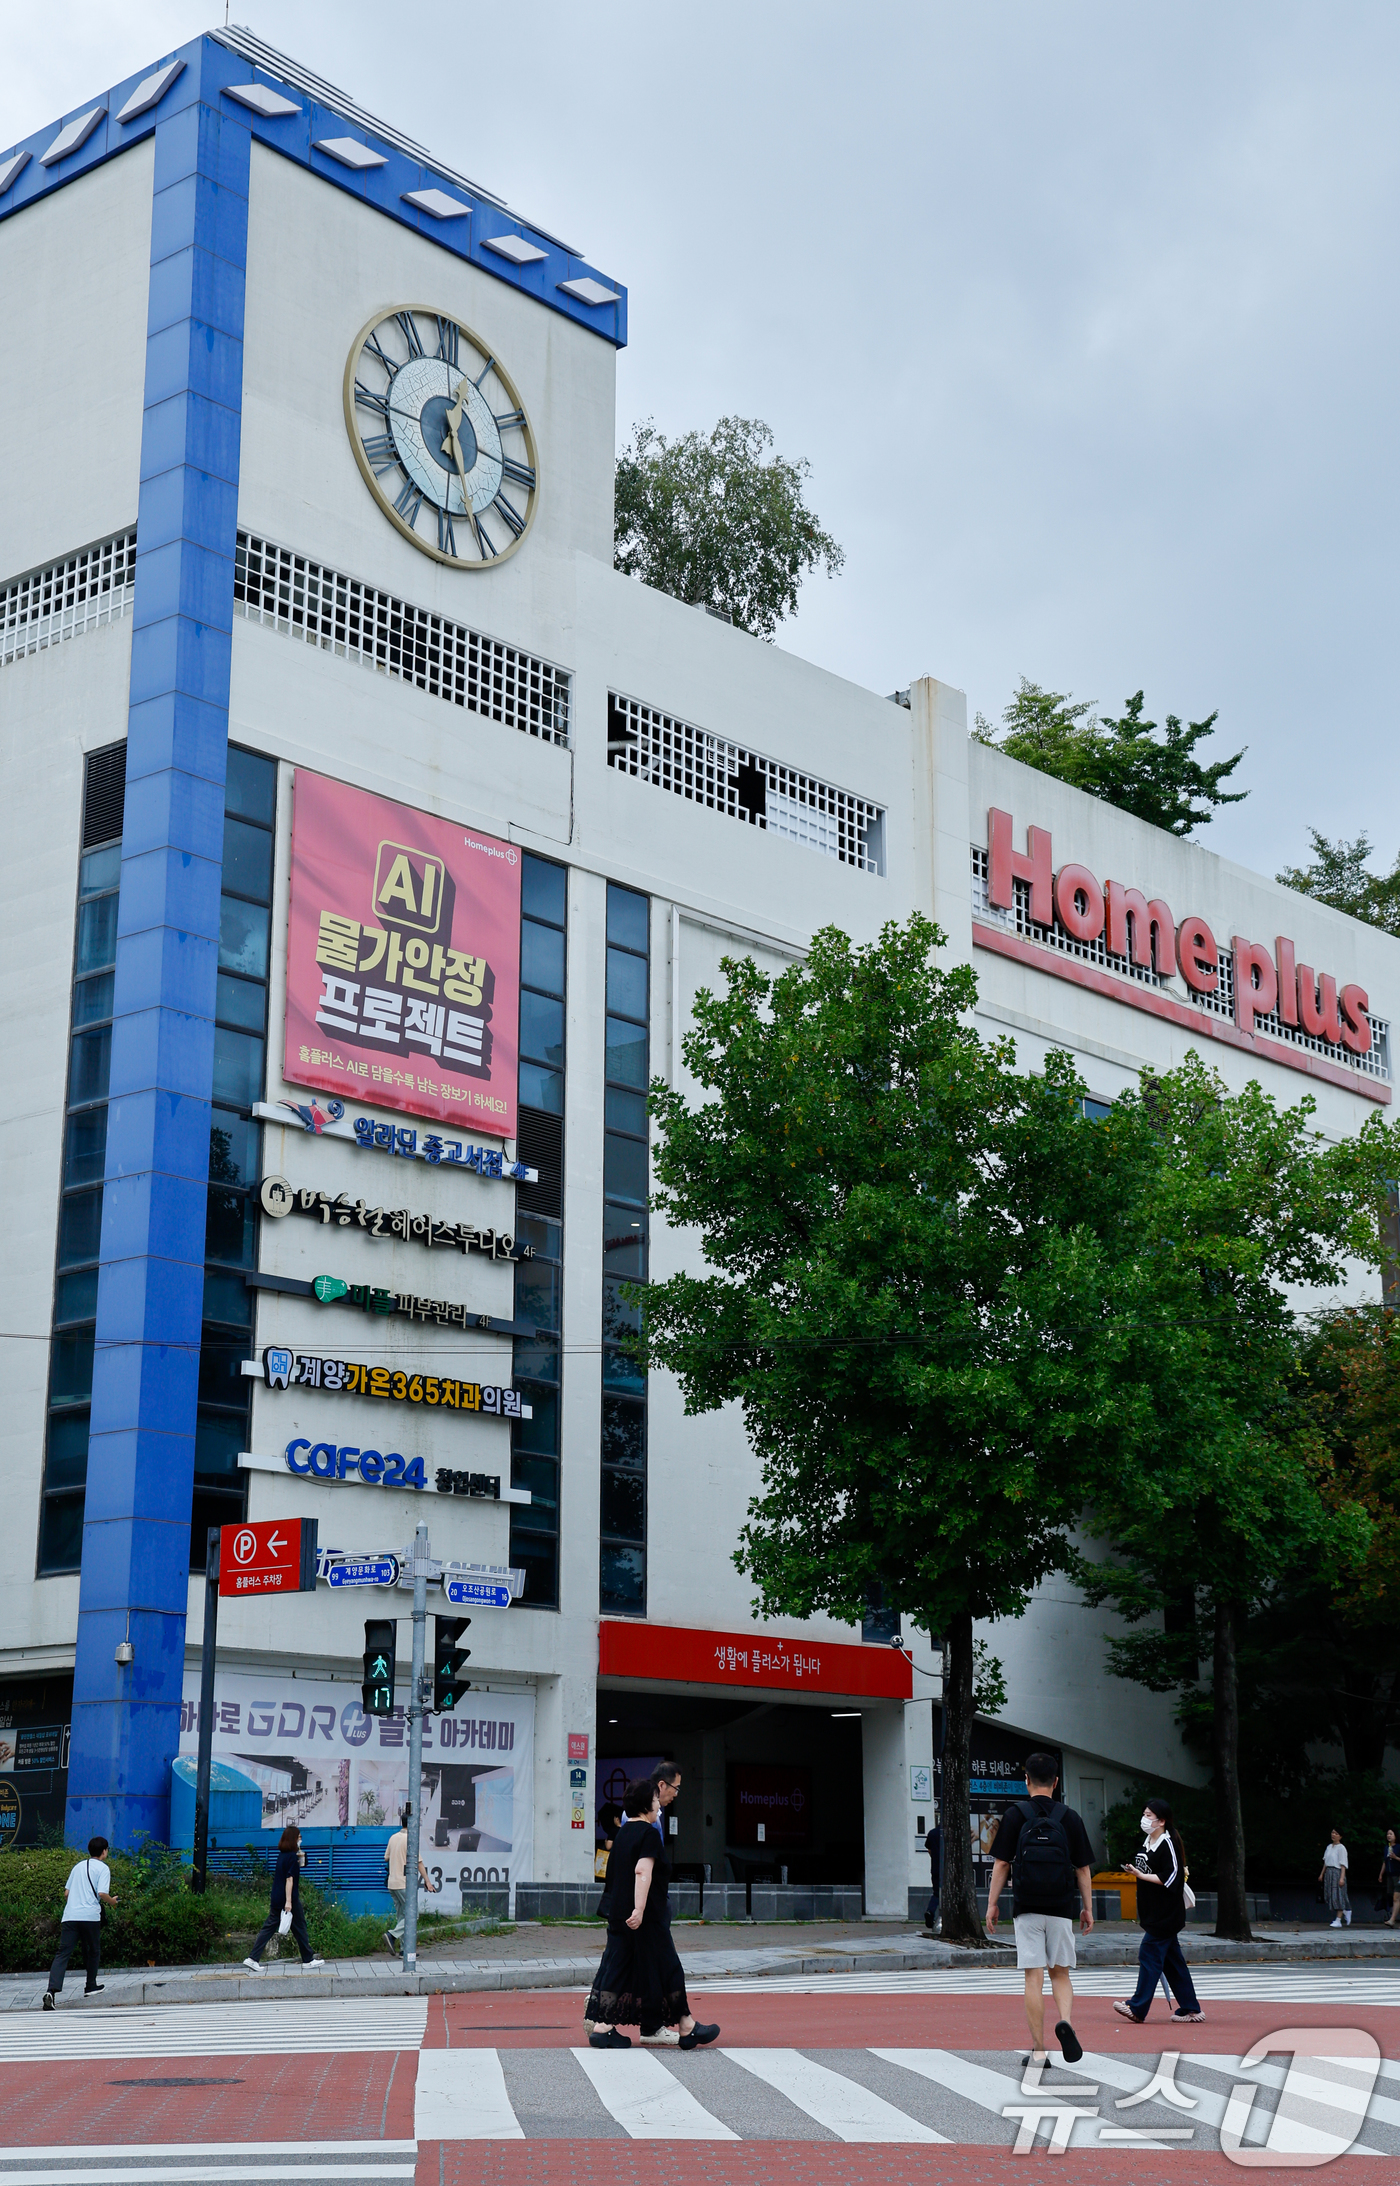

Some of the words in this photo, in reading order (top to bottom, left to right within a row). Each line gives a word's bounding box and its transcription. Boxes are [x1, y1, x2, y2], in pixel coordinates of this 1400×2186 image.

[464, 836, 505, 859] Homeplus
[377, 853, 437, 918] AI
[315, 909, 487, 1007] 물가안정
[314, 972, 485, 1066] 프로젝트
[298, 1045, 344, 1071] 홈플러스
[346, 1059, 368, 1076] AI로
[371, 1065, 415, 1090] 담을수록
[416, 1077, 438, 1097] 남는
[440, 1083, 472, 1106] 장보기
[473, 1090, 507, 1114] 하세요!
[353, 1117, 417, 1160] 알라딘
[422, 1133, 503, 1179] 중고서점
[510, 1162, 530, 1180] 4F
[523, 1245, 536, 1258] 4F
[350, 1284, 392, 1316] 미플
[397, 1293, 467, 1329] 피부관리
[477, 1314, 491, 1328] 4F
[299, 1356, 522, 1418] 계양가온365치과의원
[236, 1576, 261, 1588] 홈플러스
[263, 1574, 282, 1587] 주차장
[331, 1572, 339, 1581] 99
[345, 1565, 376, 1576] 계양문화로
[381, 1569, 390, 1577] 103
[450, 1588, 458, 1596] 20
[462, 1584, 497, 1597] 오조산공원로
[714, 1646, 748, 1671] 생활에
[751, 1650, 790, 1673] 플러스가
[793, 1653, 821, 1676] 됩니다
[374, 1687, 390, 1708] 17
[247, 1701, 336, 1741] GDR
[440, 1718, 515, 1751] 아카데미
[972, 1760, 988, 1776] 하루
[740, 1791, 789, 1808] Homeplus
